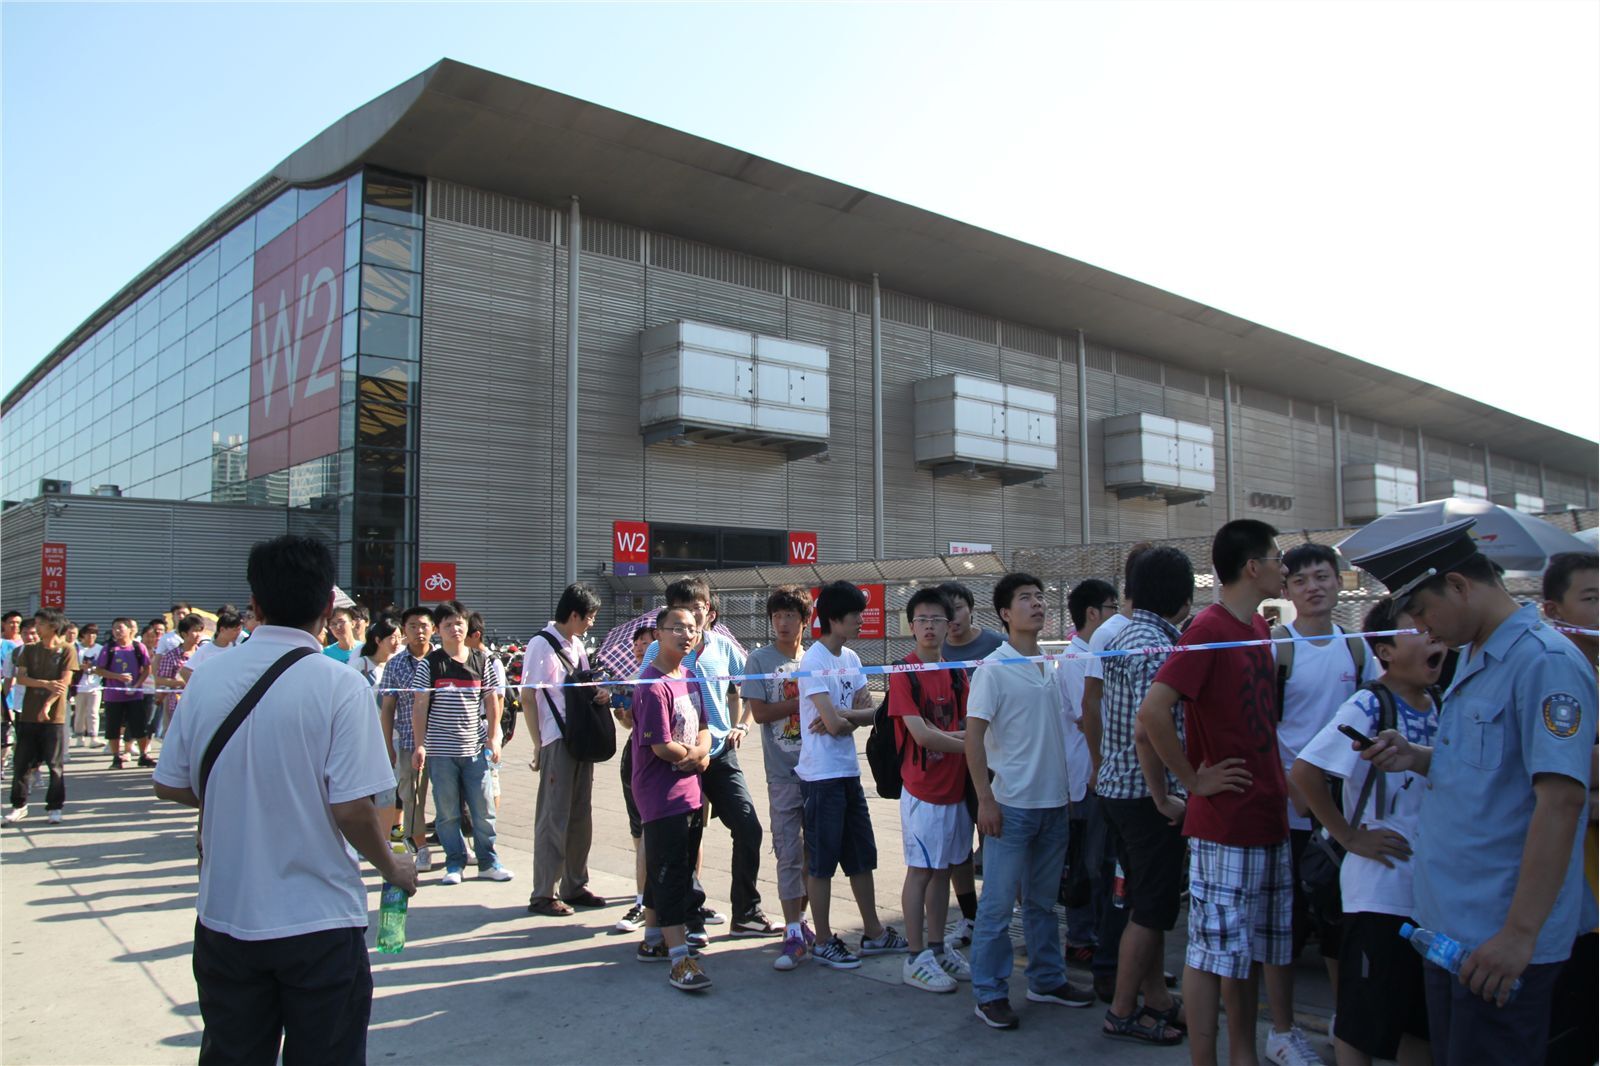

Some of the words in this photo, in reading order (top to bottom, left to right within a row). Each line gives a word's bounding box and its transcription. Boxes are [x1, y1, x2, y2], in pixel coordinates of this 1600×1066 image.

[258, 266, 337, 418] W2
[617, 531, 646, 553] W2
[791, 541, 816, 560] W2
[45, 566, 63, 576] W2
